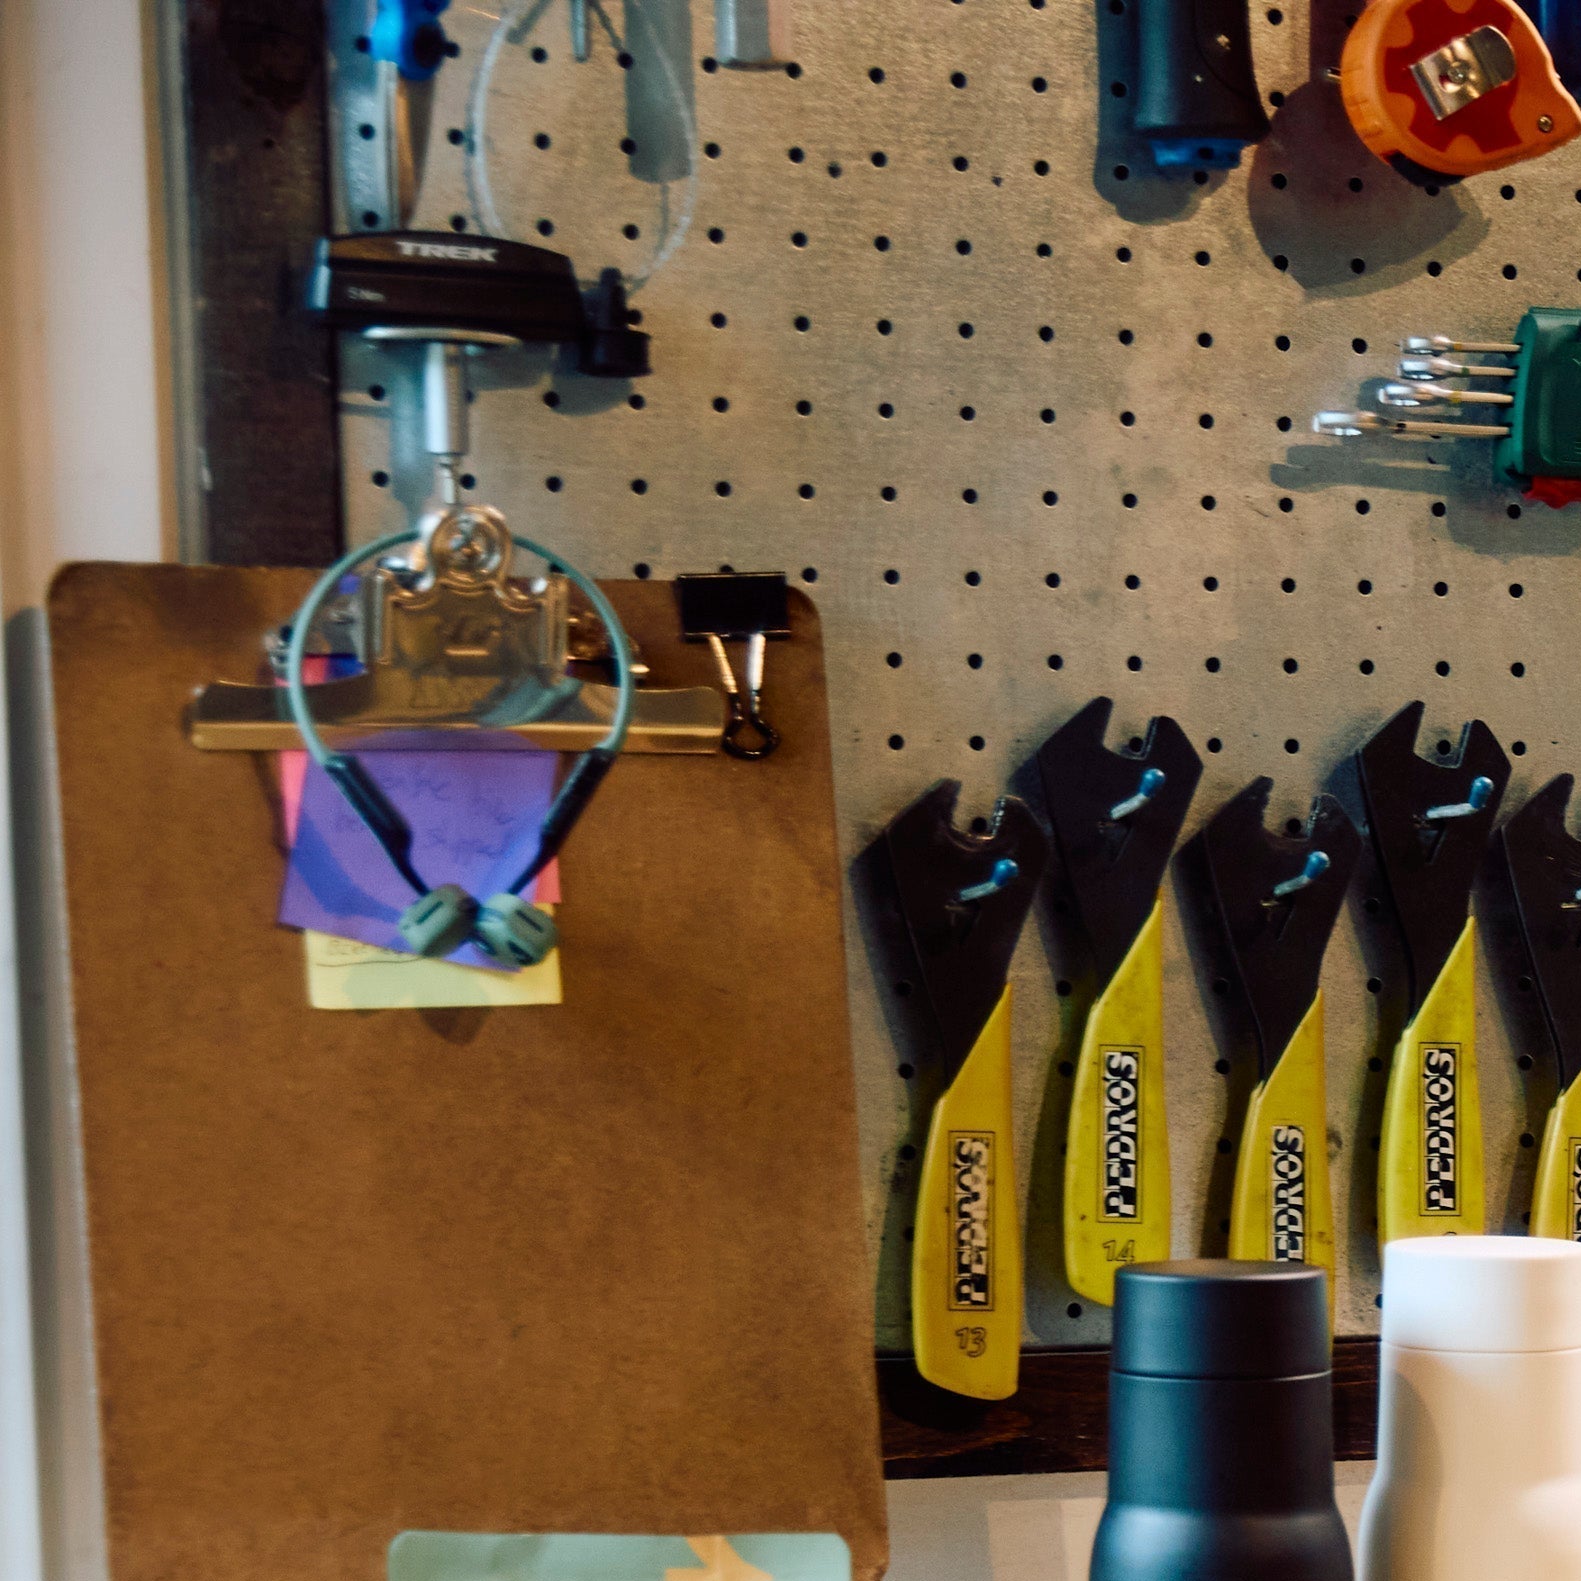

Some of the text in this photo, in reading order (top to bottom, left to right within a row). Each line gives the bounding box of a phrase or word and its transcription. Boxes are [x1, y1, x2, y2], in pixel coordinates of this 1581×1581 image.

[396, 241, 498, 262] TREK
[1102, 1050, 1140, 1220] PEDRO'S
[1271, 1124, 1305, 1262] EDRO'S
[1424, 1048, 1457, 1213] PEDRO'S
[953, 1137, 991, 1307] PEDRO'S
[1102, 1238, 1136, 1264] 14
[955, 1326, 988, 1358] 13
